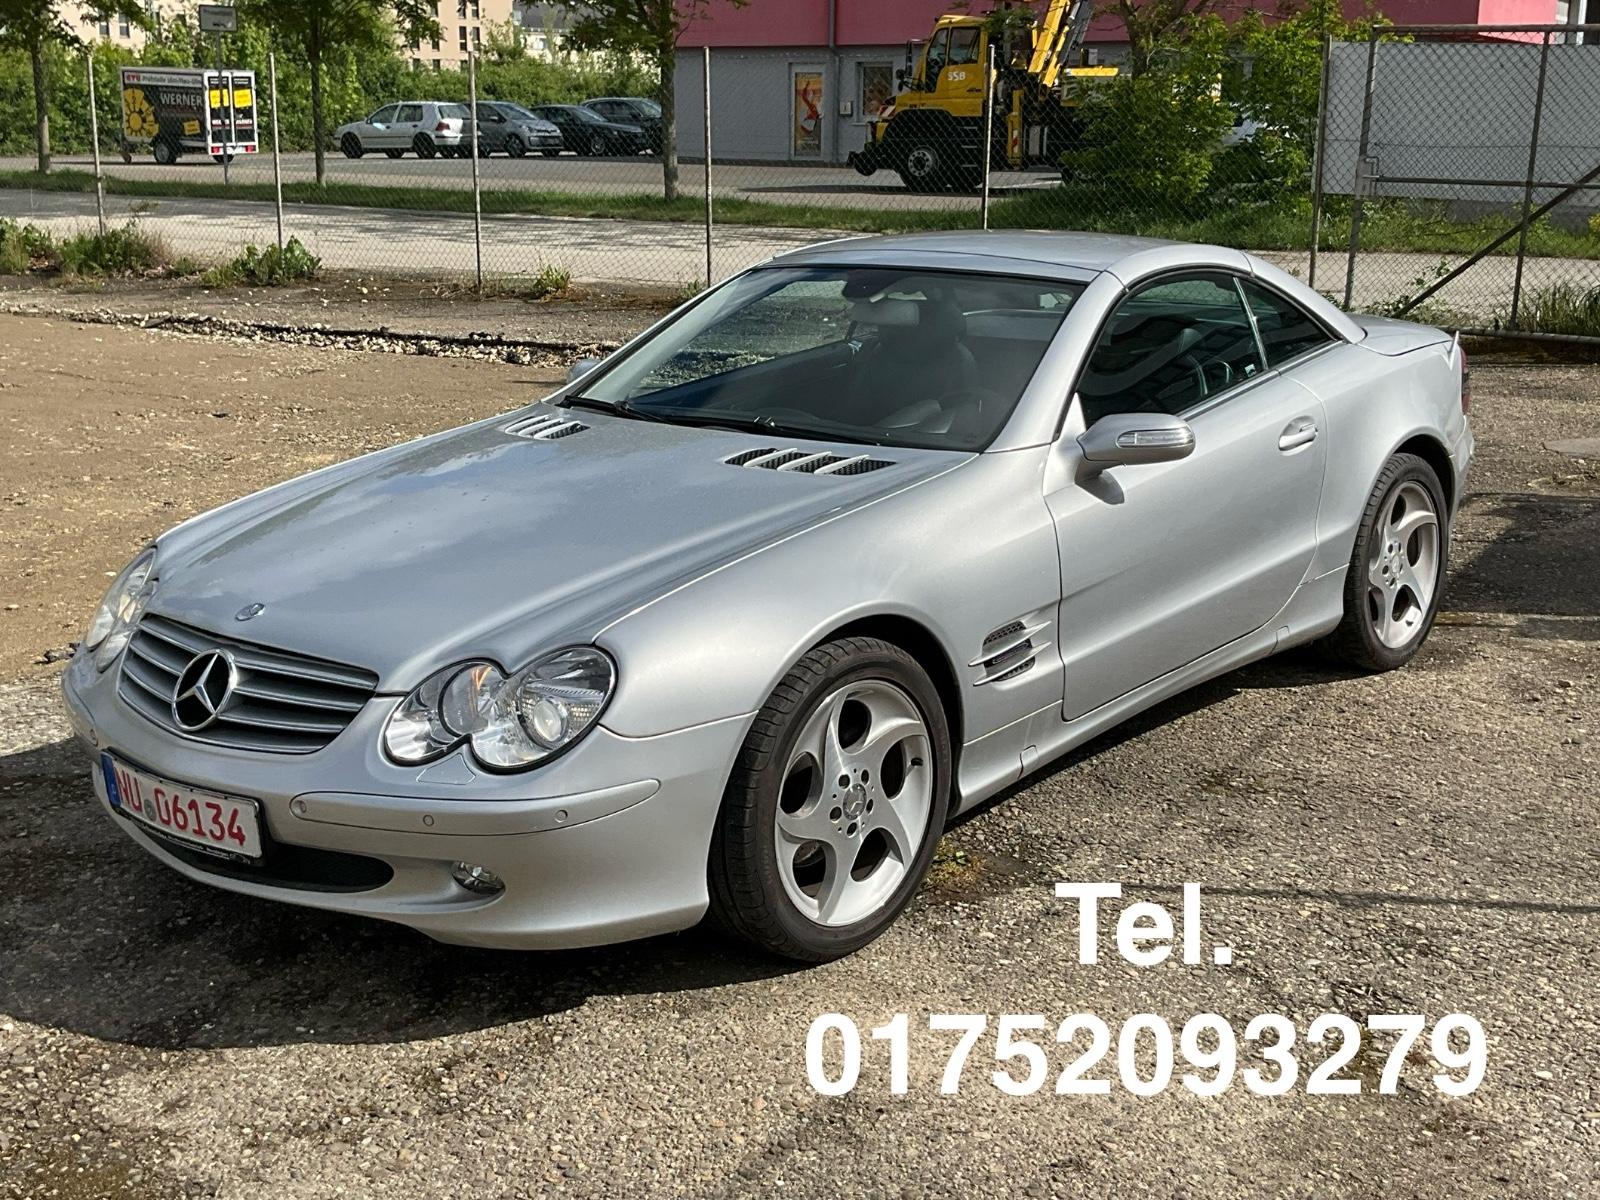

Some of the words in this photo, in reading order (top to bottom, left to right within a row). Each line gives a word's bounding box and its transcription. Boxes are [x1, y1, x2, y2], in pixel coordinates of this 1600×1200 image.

[947, 71, 966, 81] SSB
[160, 92, 203, 107] WERNER
[114, 766, 143, 812] NU
[153, 787, 246, 846] 06134
